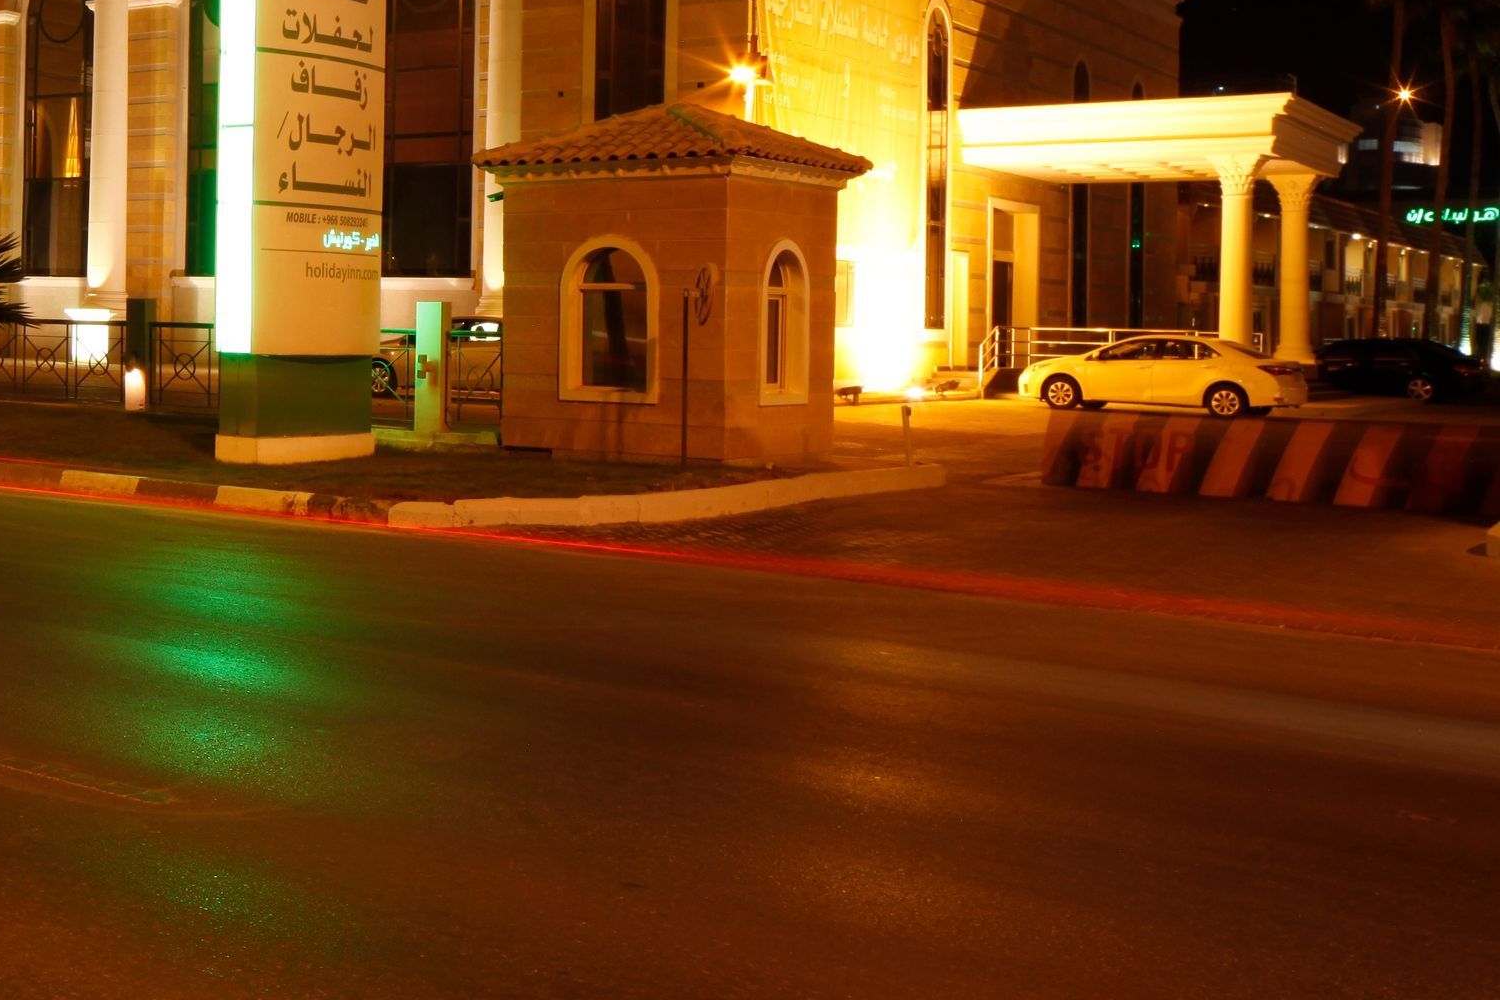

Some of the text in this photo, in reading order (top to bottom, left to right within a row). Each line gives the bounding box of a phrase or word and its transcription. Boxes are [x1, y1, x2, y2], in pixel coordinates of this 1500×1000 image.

[282, 9, 374, 53] لحفلات
[291, 60, 368, 109] زفاف
[278, 161, 372, 199] النساء
[305, 260, 379, 282] holidayinn.com
[1078, 427, 1195, 474] STOP
